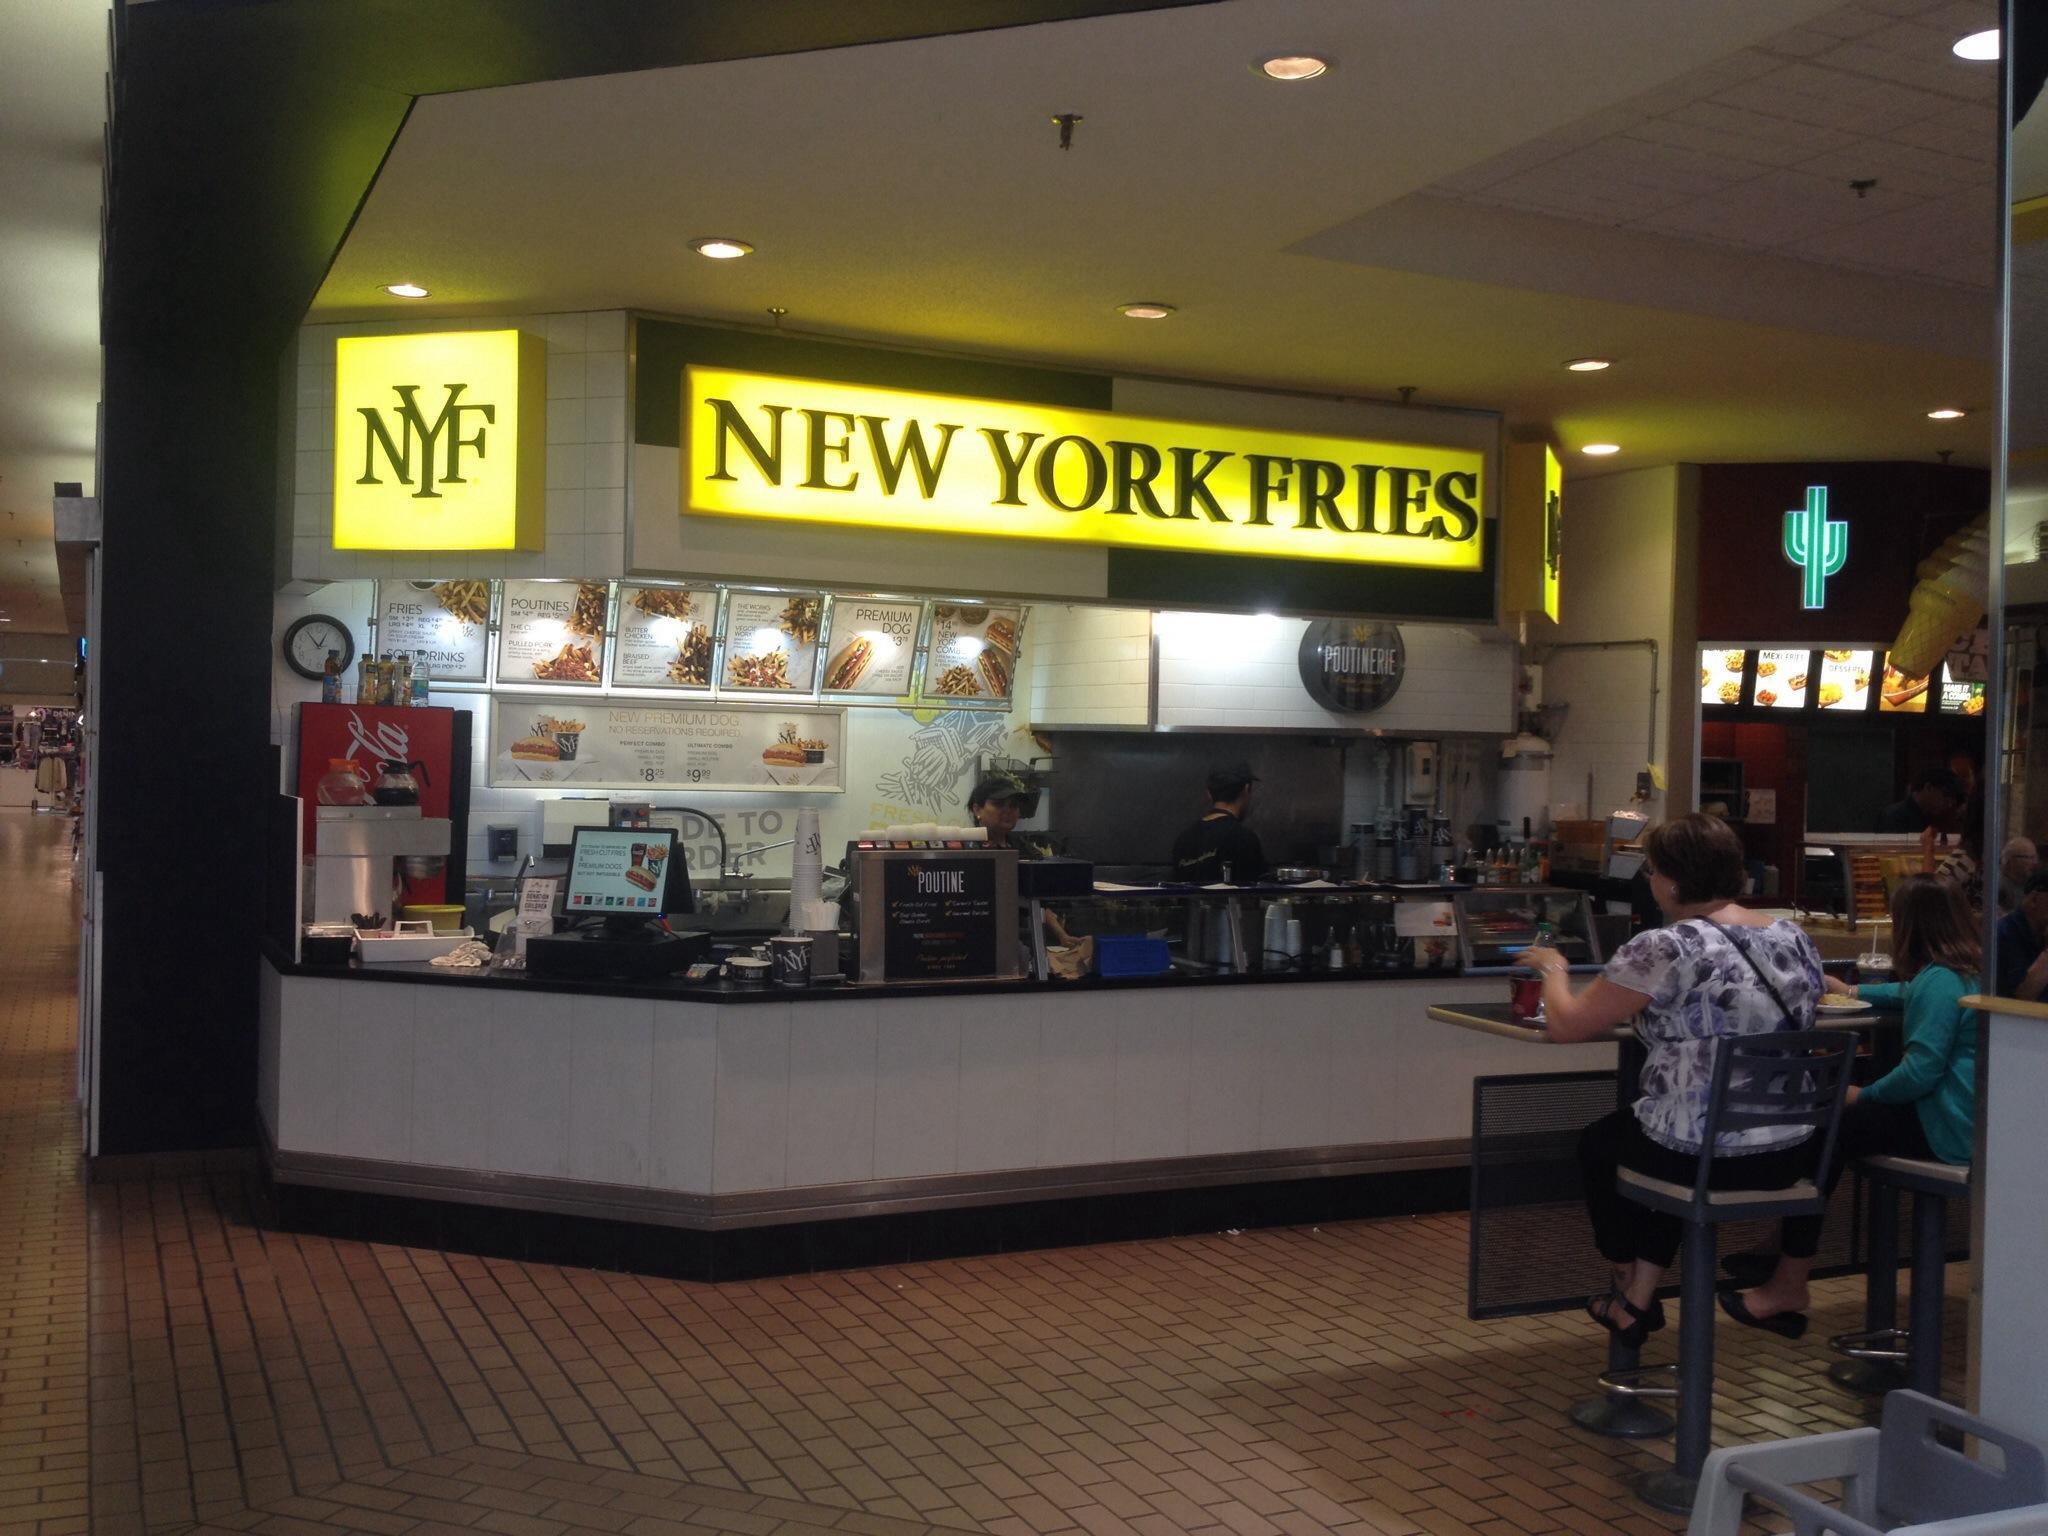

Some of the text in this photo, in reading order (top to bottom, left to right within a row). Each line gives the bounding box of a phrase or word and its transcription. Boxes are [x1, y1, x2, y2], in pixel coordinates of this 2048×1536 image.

[356, 383, 495, 498] NYF
[704, 397, 964, 500] NEW
[976, 427, 1236, 524] YORK
[1243, 453, 1479, 543] FRIES
[389, 602, 423, 615] FRIES
[511, 598, 570, 612] POUTINES
[856, 608, 912, 623] PREMIUM
[625, 626, 649, 634] BUTTER
[882, 622, 911, 635] DOG
[937, 630, 958, 639] NEW
[508, 640, 534, 648] PULLED
[623, 652, 650, 660] BRAISED
[1324, 645, 1397, 676] POUTINERIE
[609, 711, 640, 723] NEW
[644, 712, 707, 726] PREMIUM
[608, 725, 623, 734] NO
[625, 726, 694, 737] RESERVATIONS
[738, 810, 783, 836] TO
[917, 870, 965, 894] POUTINE
